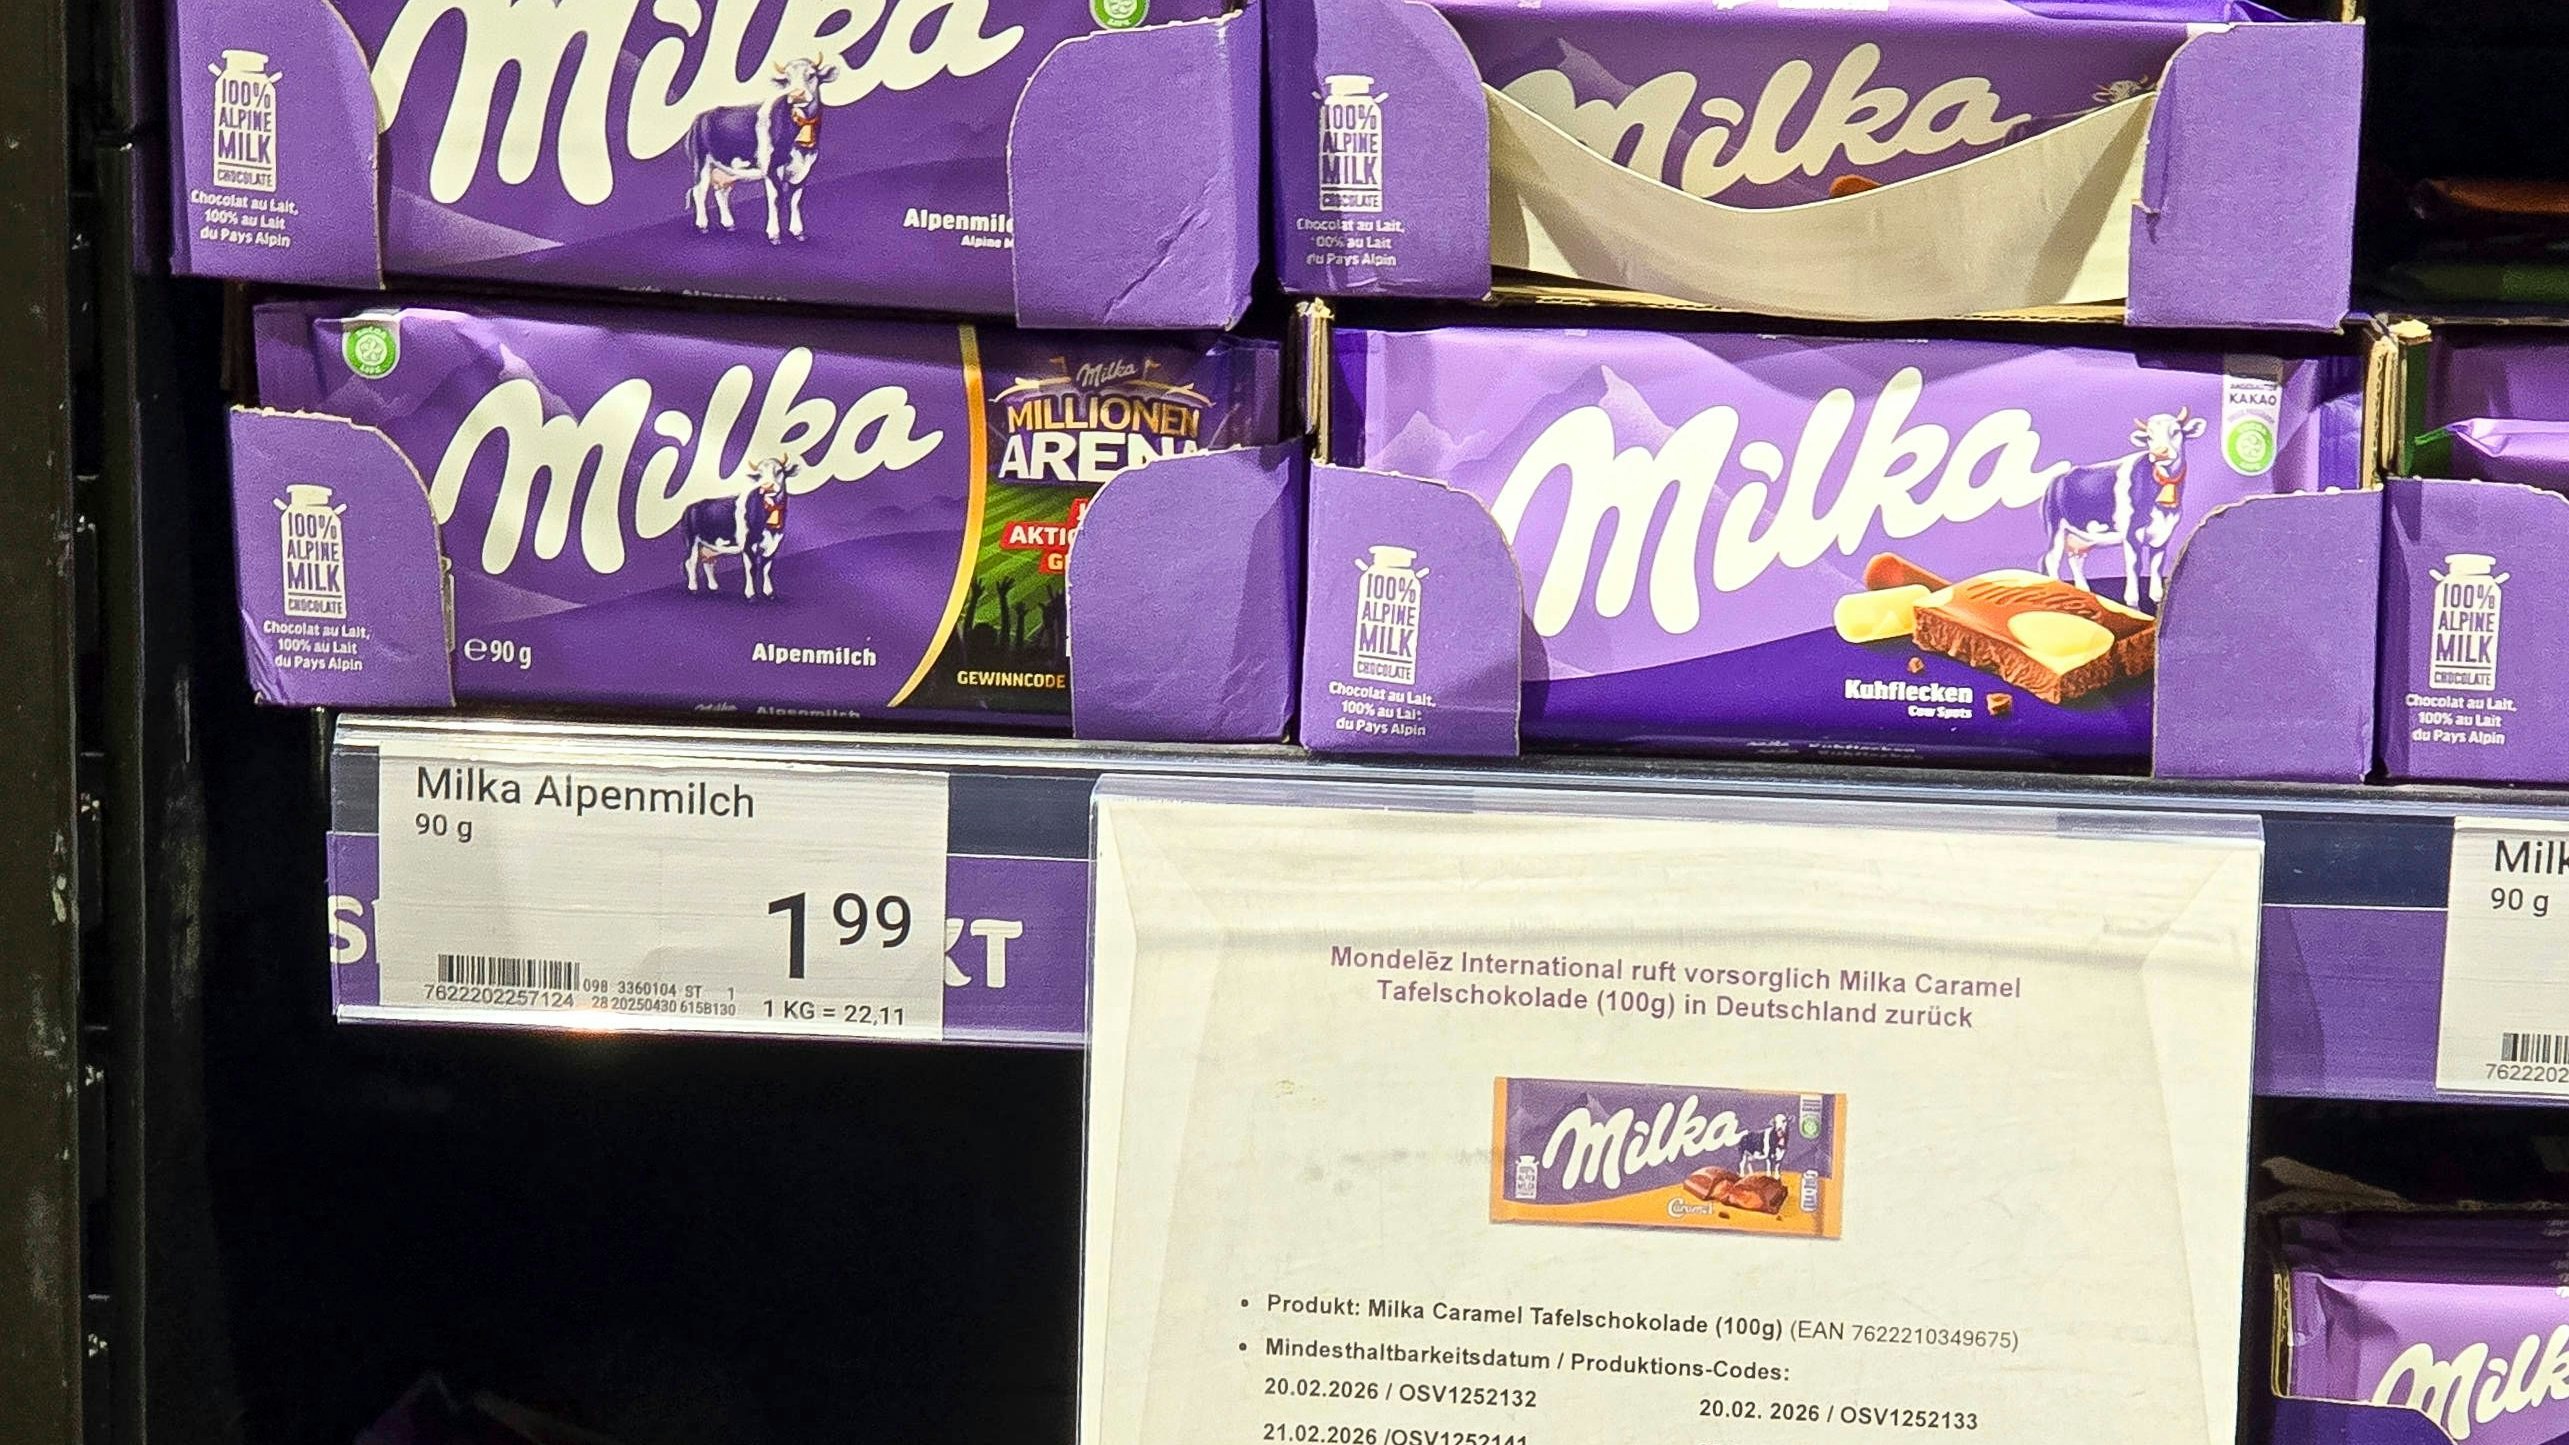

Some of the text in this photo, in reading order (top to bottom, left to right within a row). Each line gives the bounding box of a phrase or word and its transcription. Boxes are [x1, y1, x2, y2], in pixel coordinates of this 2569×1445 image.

[222, 79, 271, 108] 100%
[219, 107, 271, 132] ALPINE
[1324, 104, 1376, 130] 100%
[1503, 42, 2032, 198] Milka
[218, 130, 270, 163] MILK
[1323, 132, 1378, 153] ALPINE
[1322, 155, 1377, 184] MILK
[191, 189, 248, 208] Chocolat
[250, 198, 268, 211] au
[260, 216, 286, 230] Lait
[1356, 221, 1373, 232] au
[200, 226, 291, 248] du Pays Alpin
[1311, 236, 1345, 248] 00%
[1366, 237, 1392, 249] Lait
[1326, 252, 1359, 266] Pays
[1362, 252, 1397, 267] Alpin
[1077, 359, 1138, 387] Milka
[2229, 393, 2277, 406] KAKAO
[1008, 397, 1199, 438] MILLIONEN
[432, 347, 943, 575] Milka
[1488, 365, 2073, 637] Milka
[288, 512, 337, 539] 100%
[287, 539, 340, 561] ALPINE
[287, 562, 340, 592] MILK
[1366, 573, 1416, 603] 100%
[2443, 583, 2495, 610] 100%
[1362, 601, 1416, 627] ALPINE
[2438, 611, 2496, 632] ALPINE
[263, 620, 320, 635] Chocolat
[323, 624, 339, 637] au
[1359, 623, 1415, 658] MILK
[333, 641, 358, 654] Lait
[752, 643, 876, 666] Alpenmilch
[2435, 633, 2493, 664] MILK
[275, 655, 363, 672] du Pays Alpin
[957, 670, 1066, 688] GEWINNCODE
[1328, 681, 1386, 700] Chocolat
[1388, 690, 1405, 703] au
[1845, 679, 1973, 704] Kuhflecken
[1908, 705, 1972, 718] Cow Spots
[2405, 693, 2464, 709] Chocolat
[2466, 698, 2484, 710] au
[1335, 716, 1426, 737] du Pays Alpin
[2474, 714, 2503, 727] Lait
[2412, 728, 2505, 745] du Pays Alpin
[417, 767, 753, 818] Milka Alpenmilch
[415, 814, 473, 843] 90 g
[2491, 888, 2549, 917] 90 g
[768, 892, 911, 979] 1 99
[1330, 946, 2021, 998] Mondelēz International ruft vorsorglich Milka Caramel
[424, 984, 575, 1008] 7622202257124
[583, 978, 608, 993] 098
[617, 980, 676, 996] 3360104
[727, 987, 734, 1001] 1
[591, 995, 609, 1009] 28
[611, 996, 677, 1013] 20250430
[763, 1000, 773, 1018] 1
[784, 1001, 815, 1019] KG
[844, 1004, 903, 1026] 22,11
[1377, 980, 1973, 1028] Tafelschokolade (100g) in Deutschland zurück
[1542, 1095, 1748, 1190] Milka
[1267, 1294, 2019, 1353] Produkt: Milka Caramel Tafelschokolade (100g) (EAN 7622210349675)
[1266, 1338, 1791, 1382] Mindesthaltbarkeitsdatum / Produktions-Codes:
[1264, 1377, 1537, 1408] 20.02.2026 / OSV1252132
[1699, 1400, 1979, 1431] 20.02. 2026 / OSV1252133
[1263, 1423, 1377, 1445] 21.02.2026
